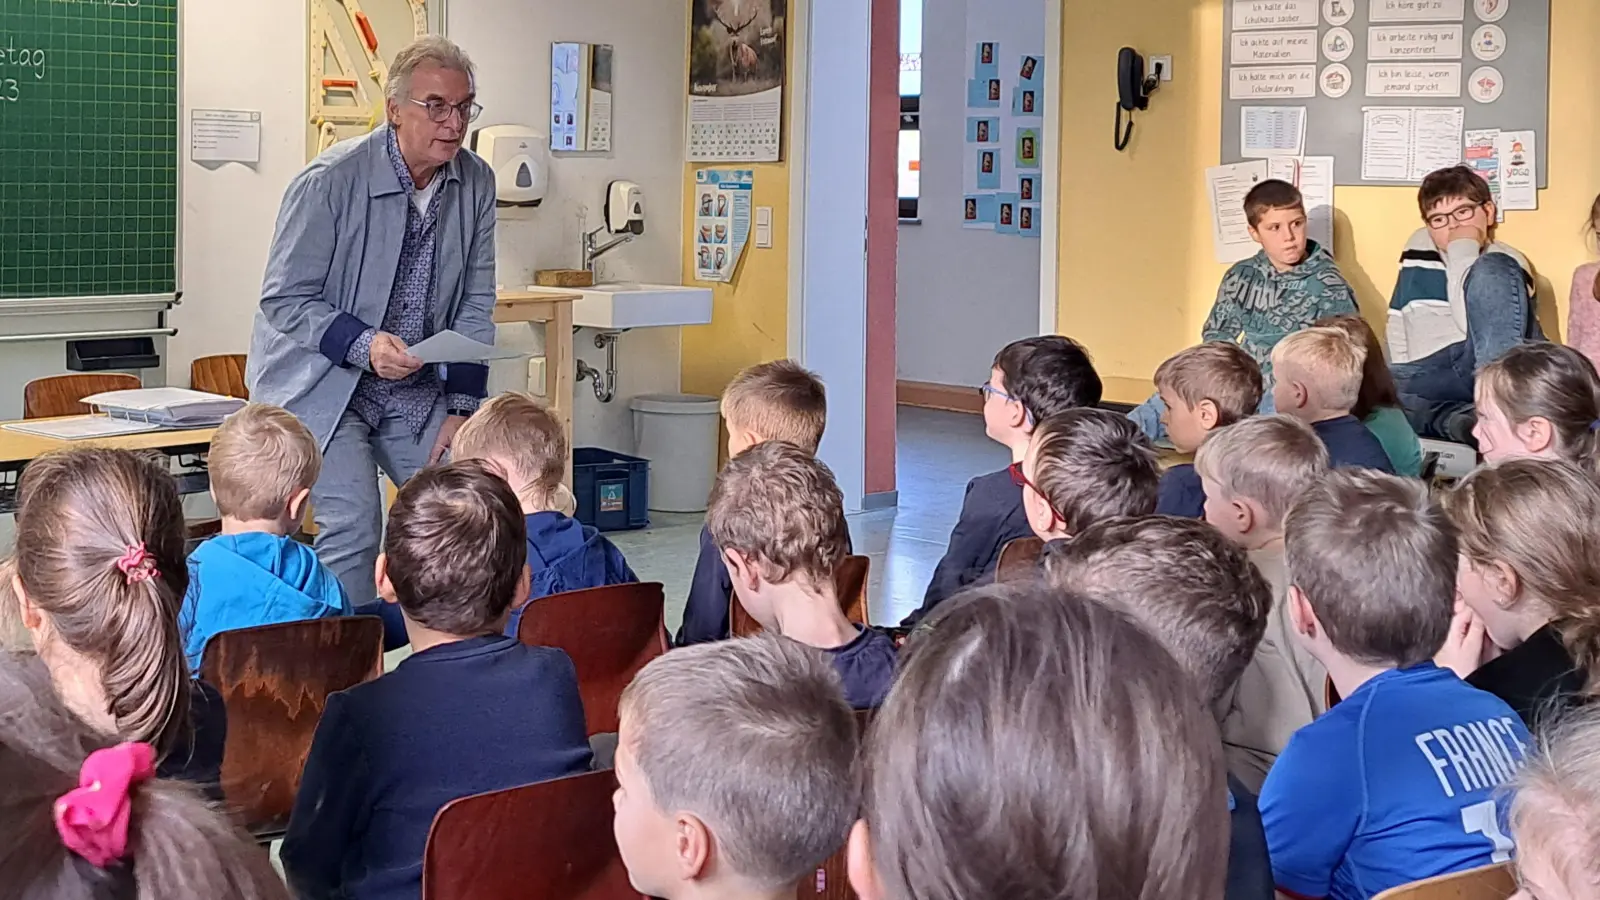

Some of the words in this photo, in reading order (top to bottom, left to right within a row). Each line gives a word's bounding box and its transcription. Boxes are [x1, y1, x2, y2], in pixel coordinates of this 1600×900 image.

[1252, 3, 1262, 12] Ich
[1264, 3, 1281, 11] halte
[1284, 2, 1297, 10] das
[1385, 1, 1395, 10] Ich
[1244, 16, 1275, 25] Schulhaus
[1376, 32, 1386, 42] Ich
[1389, 31, 1416, 41] arbeite
[1419, 32, 1438, 43] ruhig
[1440, 31, 1454, 41] und
[1239, 38, 1248, 47] Ich
[1250, 38, 1269, 47] achte
[1271, 37, 1284, 46] auf
[1252, 50, 1292, 59] Materialien
[1389, 46, 1436, 54] konzentriert
[1238, 73, 1248, 81] Ich
[1249, 72, 1267, 81] halte
[1269, 72, 1285, 80] mich
[1378, 69, 1388, 78] Ich
[1390, 69, 1402, 78] bin
[1251, 84, 1295, 94] Schulordnung
[1383, 81, 1411, 92] jemand
